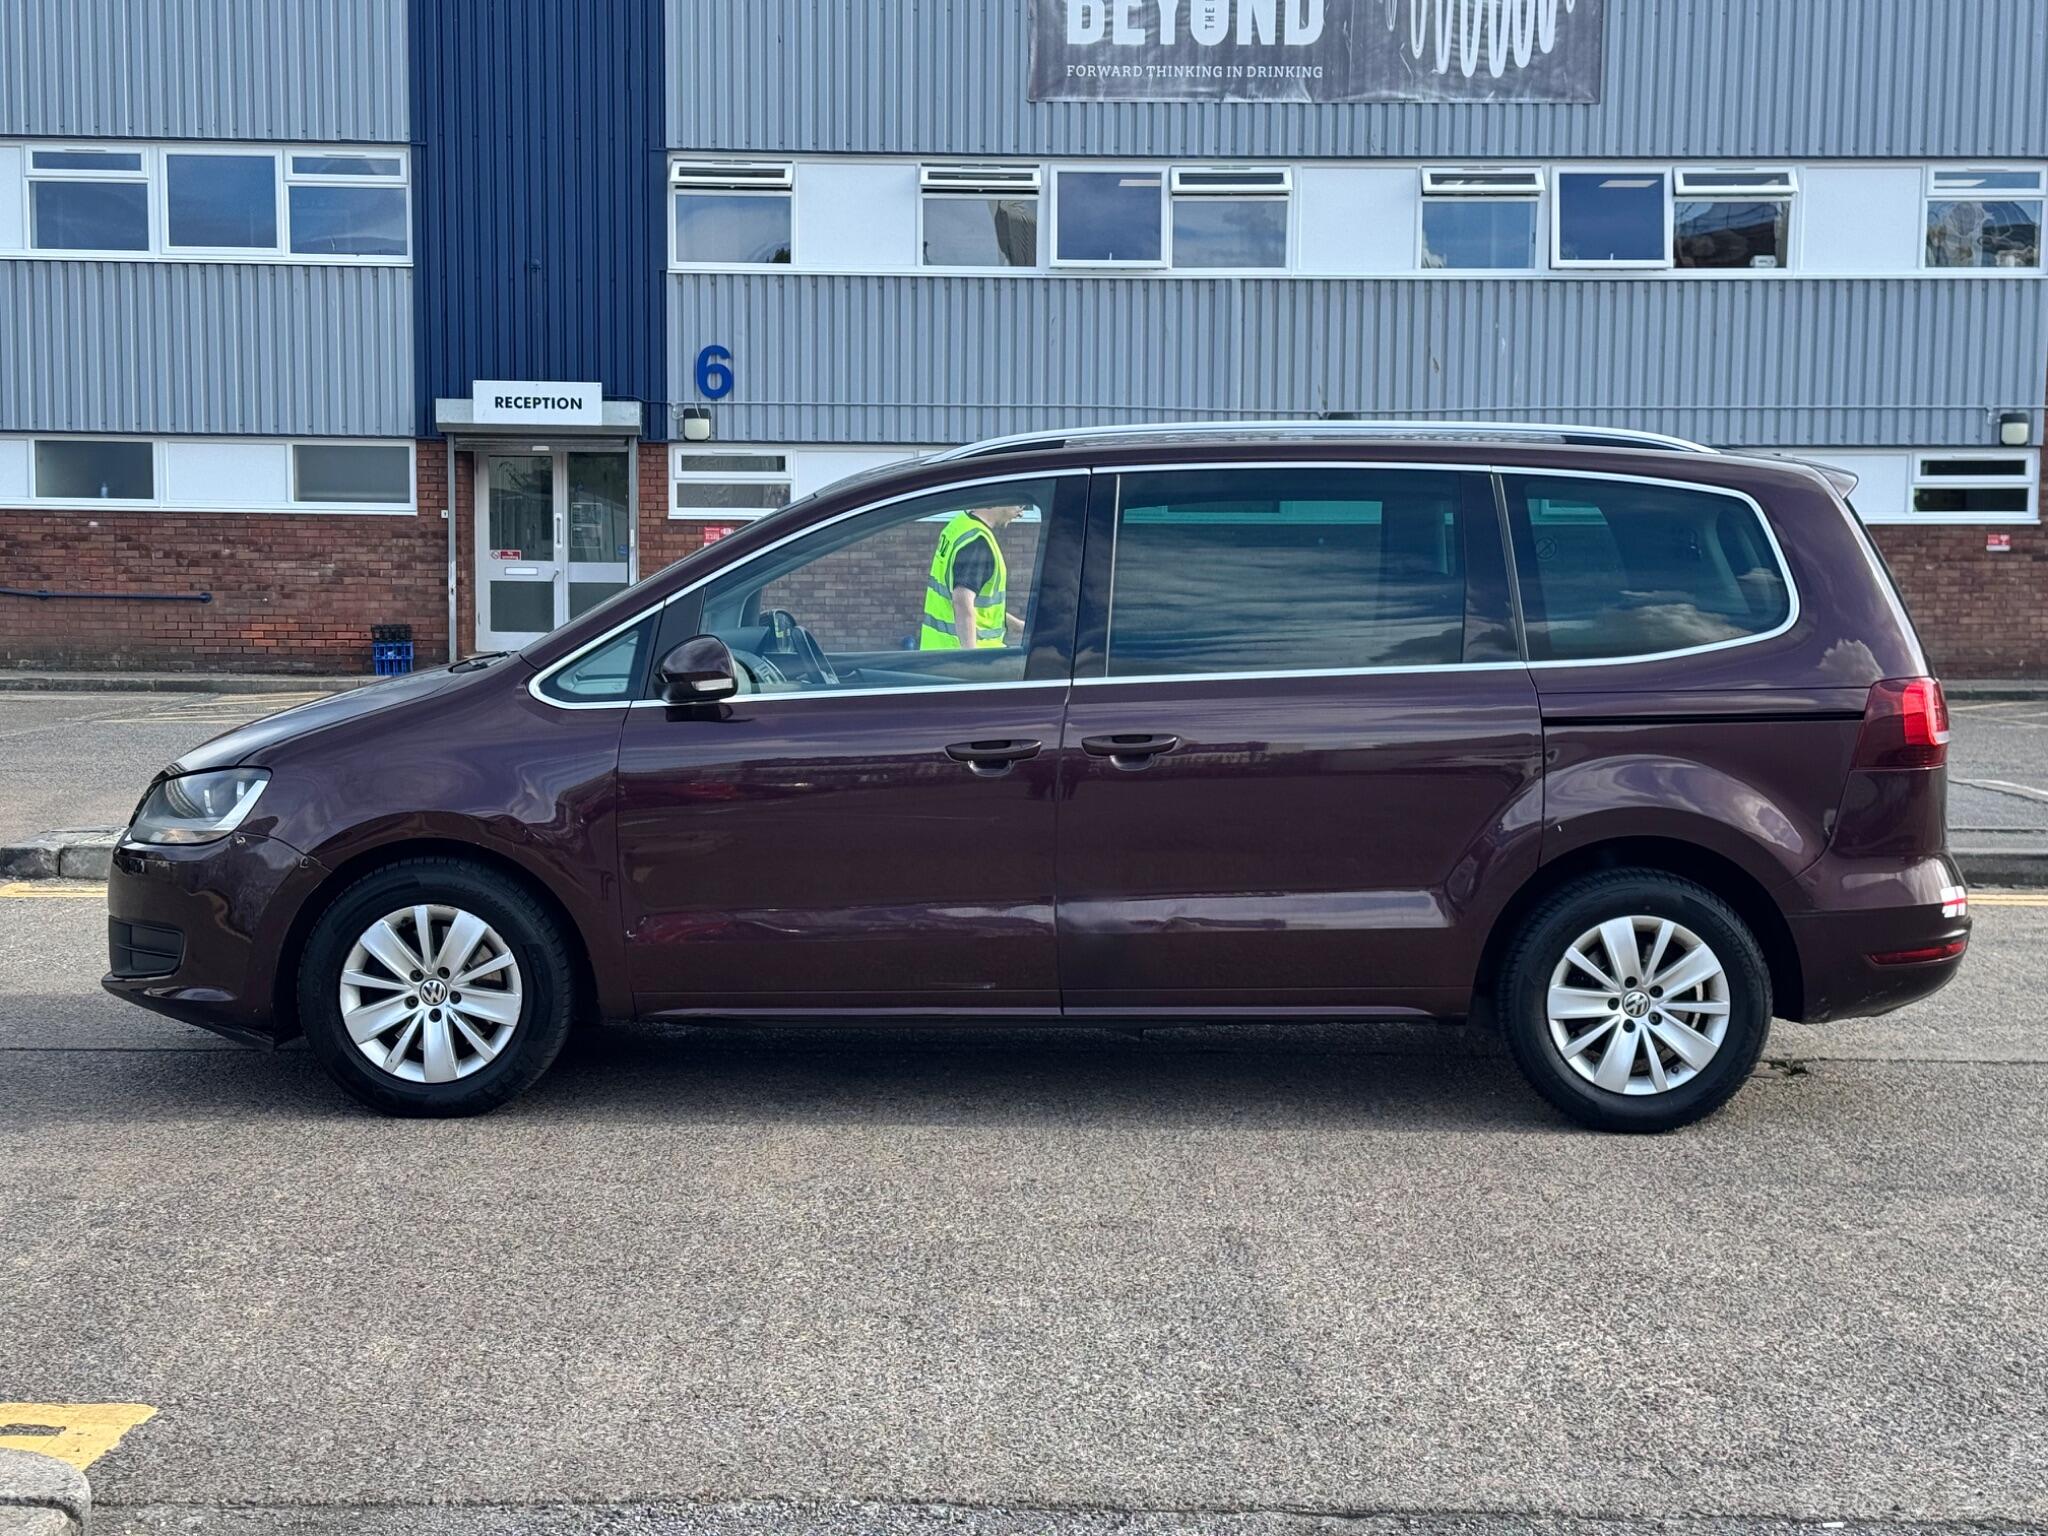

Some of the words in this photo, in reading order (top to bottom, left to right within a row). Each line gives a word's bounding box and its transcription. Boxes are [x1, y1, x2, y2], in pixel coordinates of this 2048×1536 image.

[1204, 7, 1215, 30] THE
[1066, 64, 1143, 78] FORWARD
[1146, 65, 1223, 78] THINKING
[1226, 65, 1243, 78] IN
[1246, 65, 1323, 79] DRINKING
[696, 344, 733, 399] 6
[494, 396, 583, 411] RECEPTION
